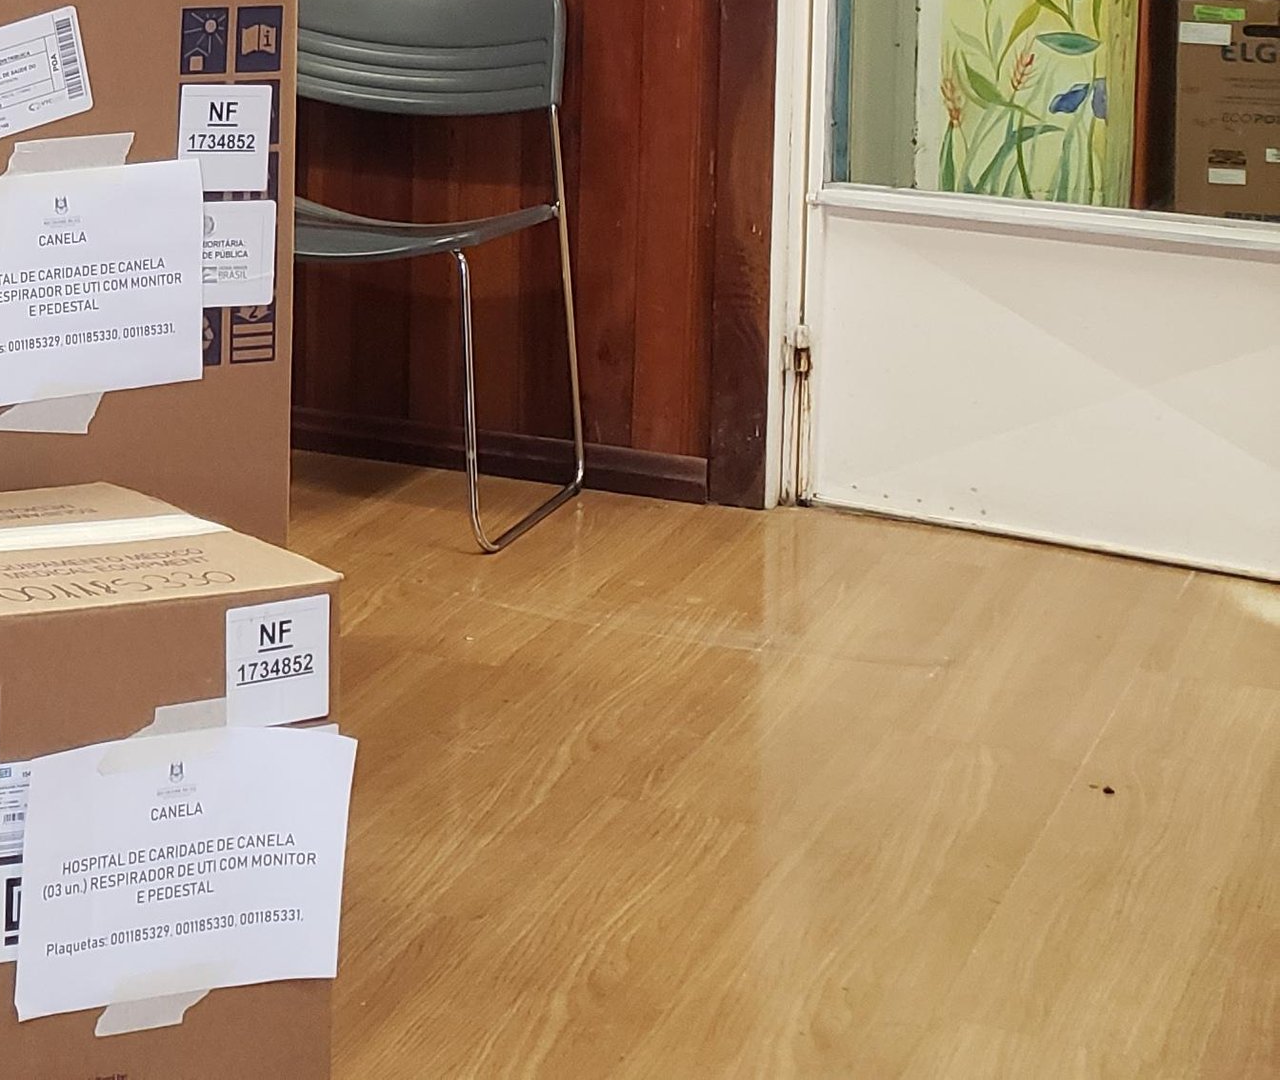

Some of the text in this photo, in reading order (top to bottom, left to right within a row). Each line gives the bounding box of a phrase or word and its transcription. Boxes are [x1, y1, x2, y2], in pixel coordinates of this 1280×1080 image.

[209, 102, 238, 121] NF
[188, 134, 255, 149] 1734852
[39, 232, 87, 246] CANELA
[20, 271, 36, 283] DE
[38, 265, 98, 281] CARIDADE
[100, 262, 116, 275] DE
[118, 258, 165, 272] CANELA
[65, 284, 81, 295] DE
[83, 280, 100, 293] UTI
[103, 278, 128, 291] COM
[131, 272, 182, 288] MONITOR
[30, 299, 99, 316] E PEDESTAL
[260, 620, 292, 646] NF
[237, 653, 313, 681] 1734852
[151, 802, 203, 821] CANELA
[137, 880, 214, 903] E PEDESTAL
